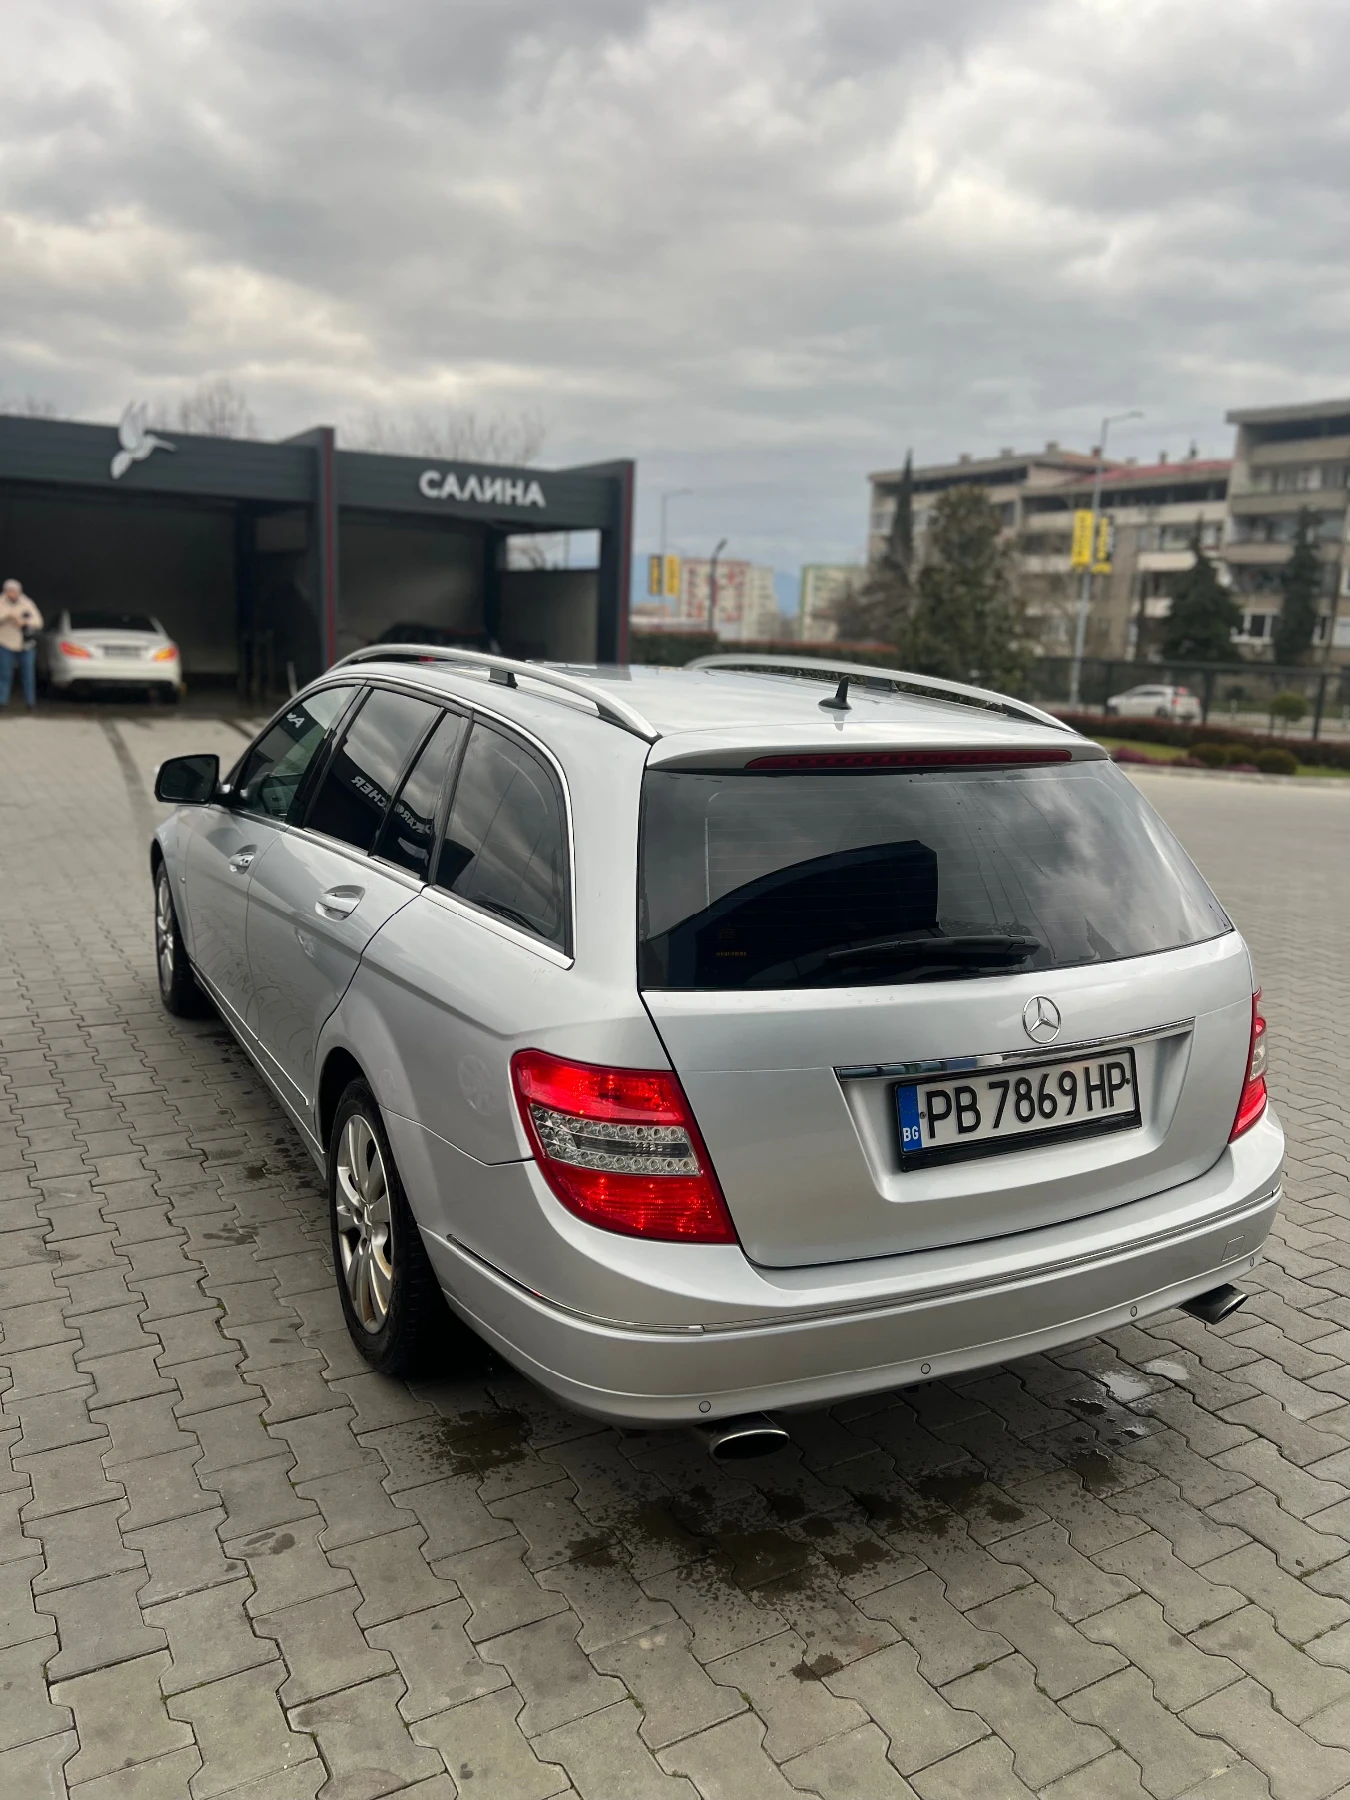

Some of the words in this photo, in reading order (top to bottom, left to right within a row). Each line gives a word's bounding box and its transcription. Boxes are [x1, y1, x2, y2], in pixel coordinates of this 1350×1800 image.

[419, 469, 547, 508] САЛИНА
[988, 1070, 1078, 1129] 7869
[903, 1126, 920, 1142] BG
